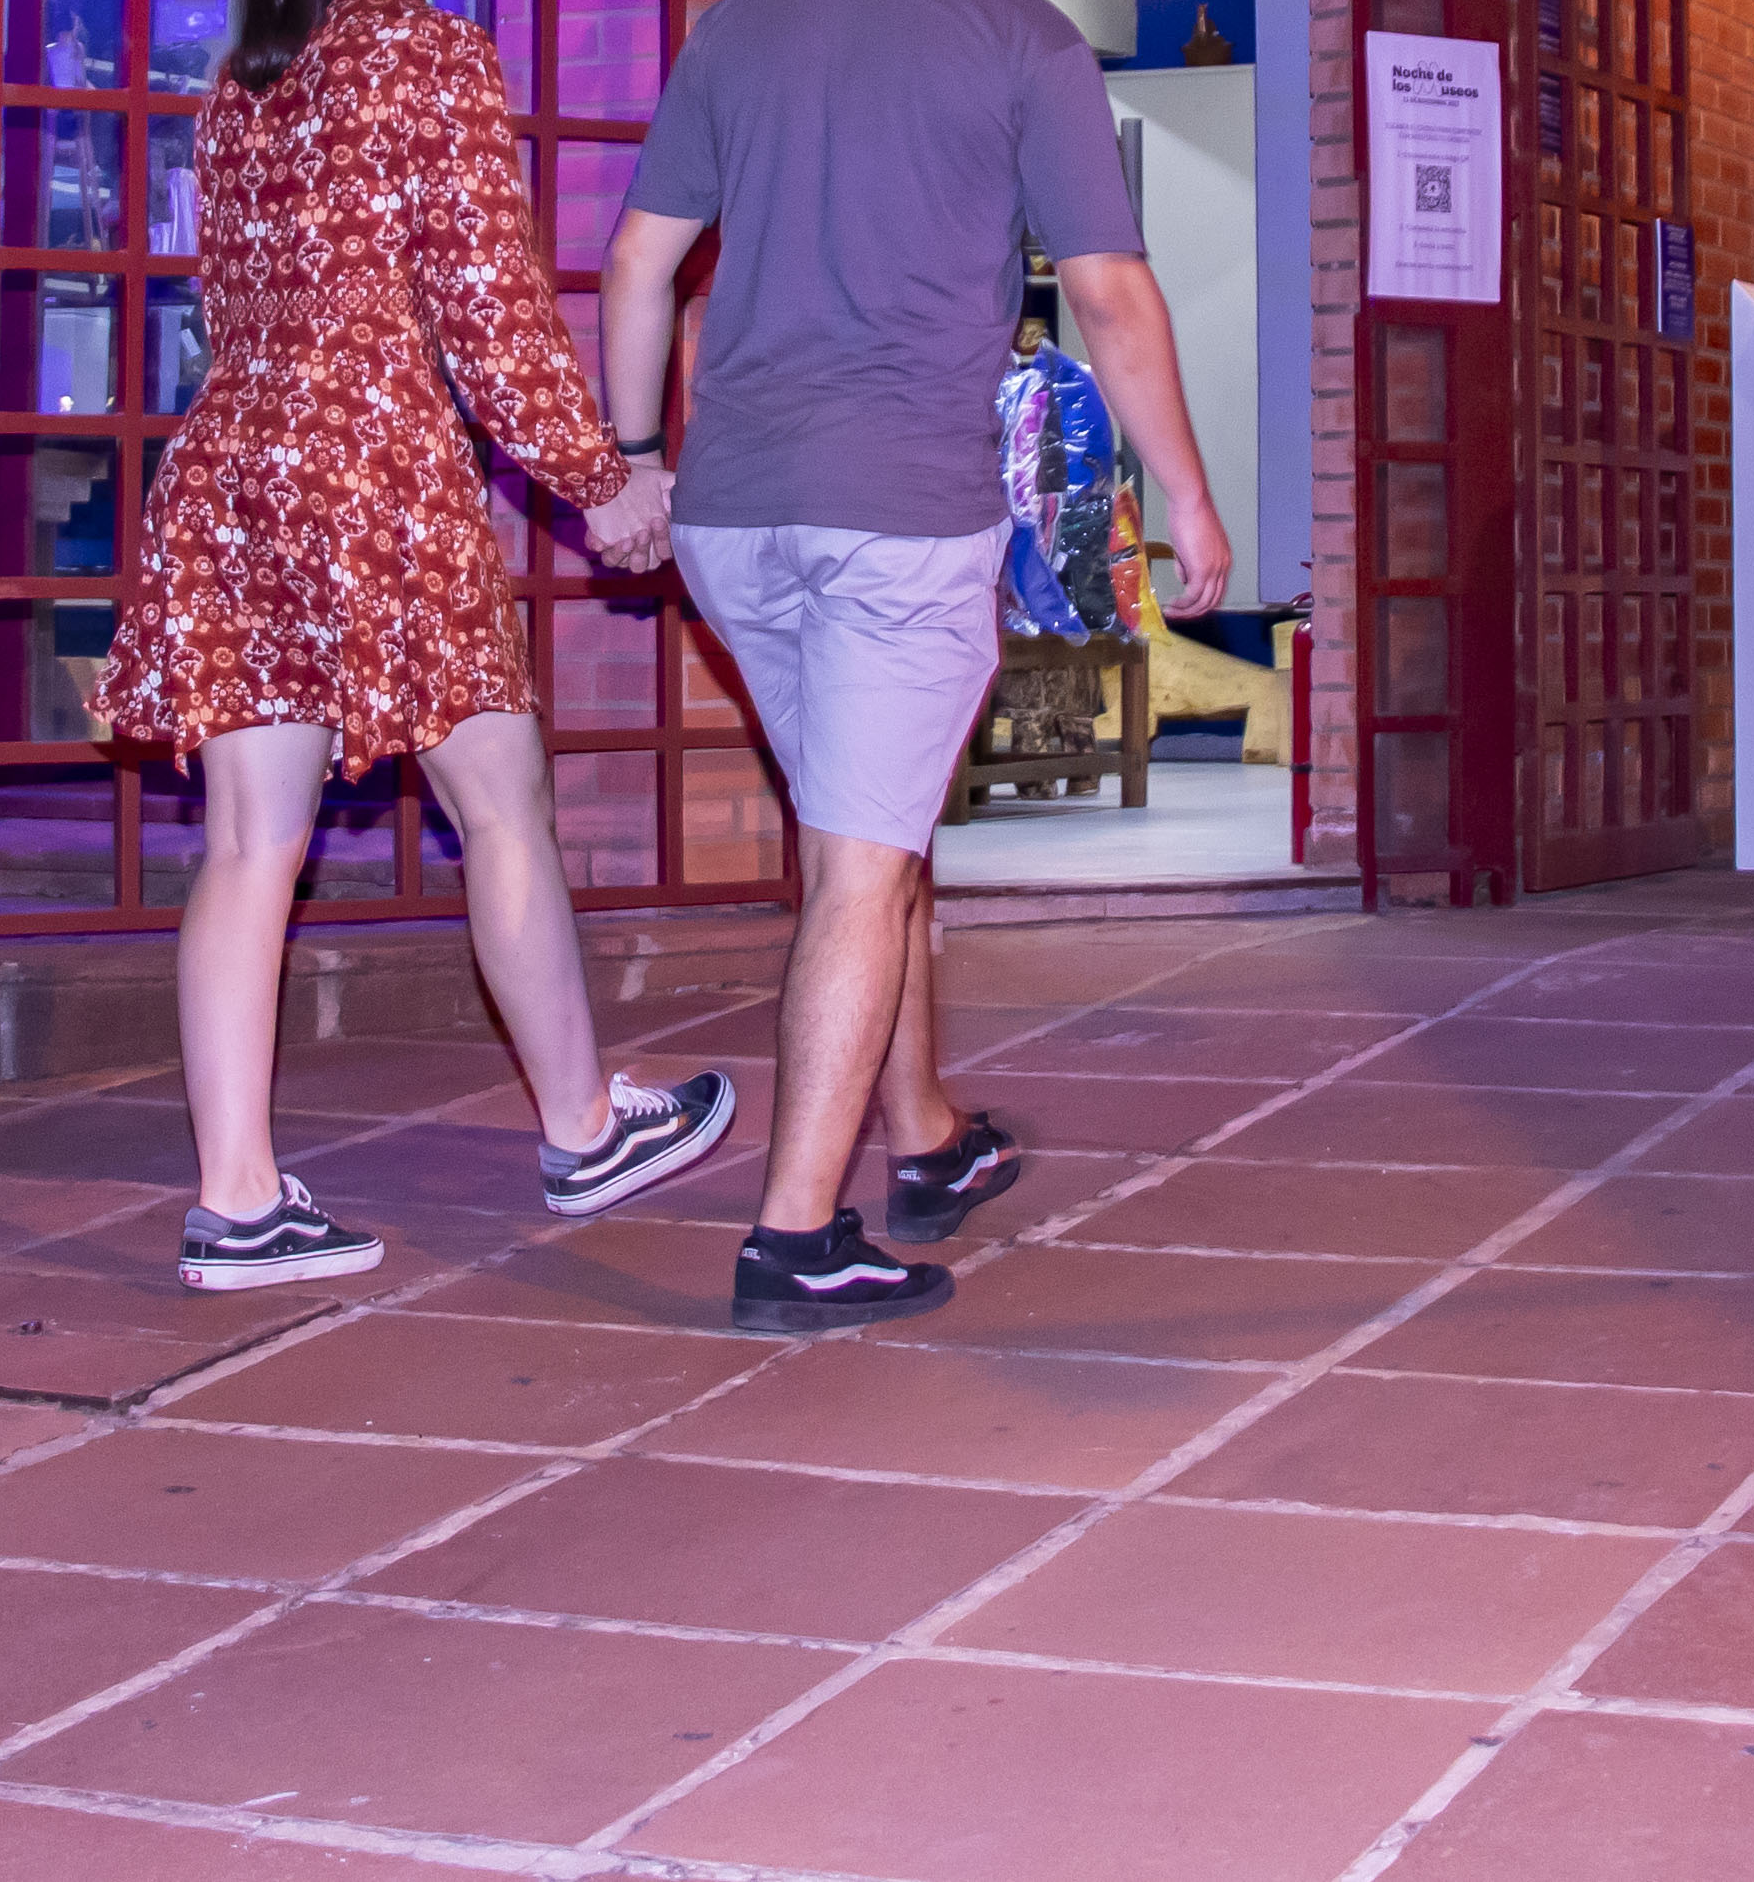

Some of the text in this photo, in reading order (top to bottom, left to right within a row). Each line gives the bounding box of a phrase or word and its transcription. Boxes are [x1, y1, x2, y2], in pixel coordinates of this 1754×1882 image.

[1392, 65, 1453, 82] Noche de
[1392, 78, 1412, 92] los
